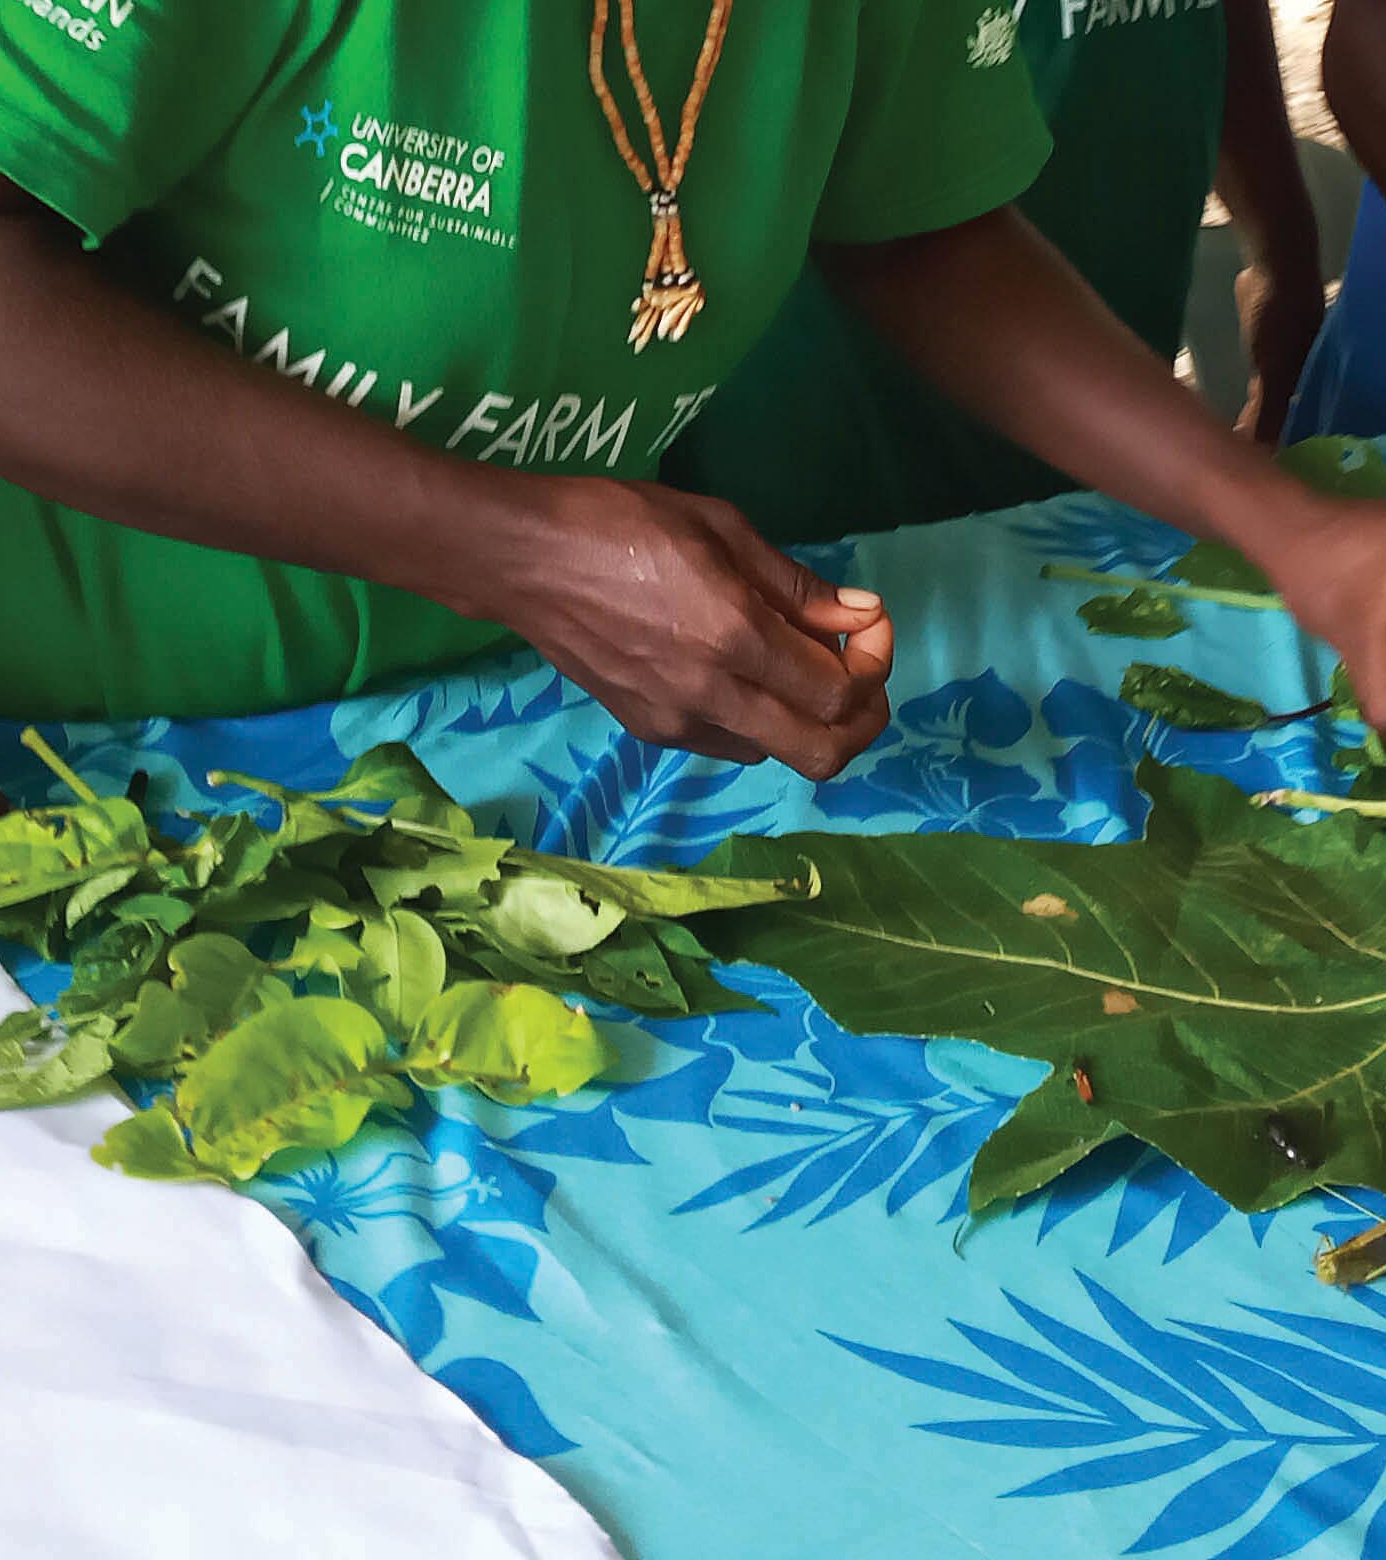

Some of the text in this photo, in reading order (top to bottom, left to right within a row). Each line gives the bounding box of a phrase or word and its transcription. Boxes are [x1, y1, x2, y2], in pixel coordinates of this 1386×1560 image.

[339, 142, 491, 218] CANBERRA
[351, 112, 506, 176] UNIVERSITY OF
[444, 390, 638, 469] FARM
